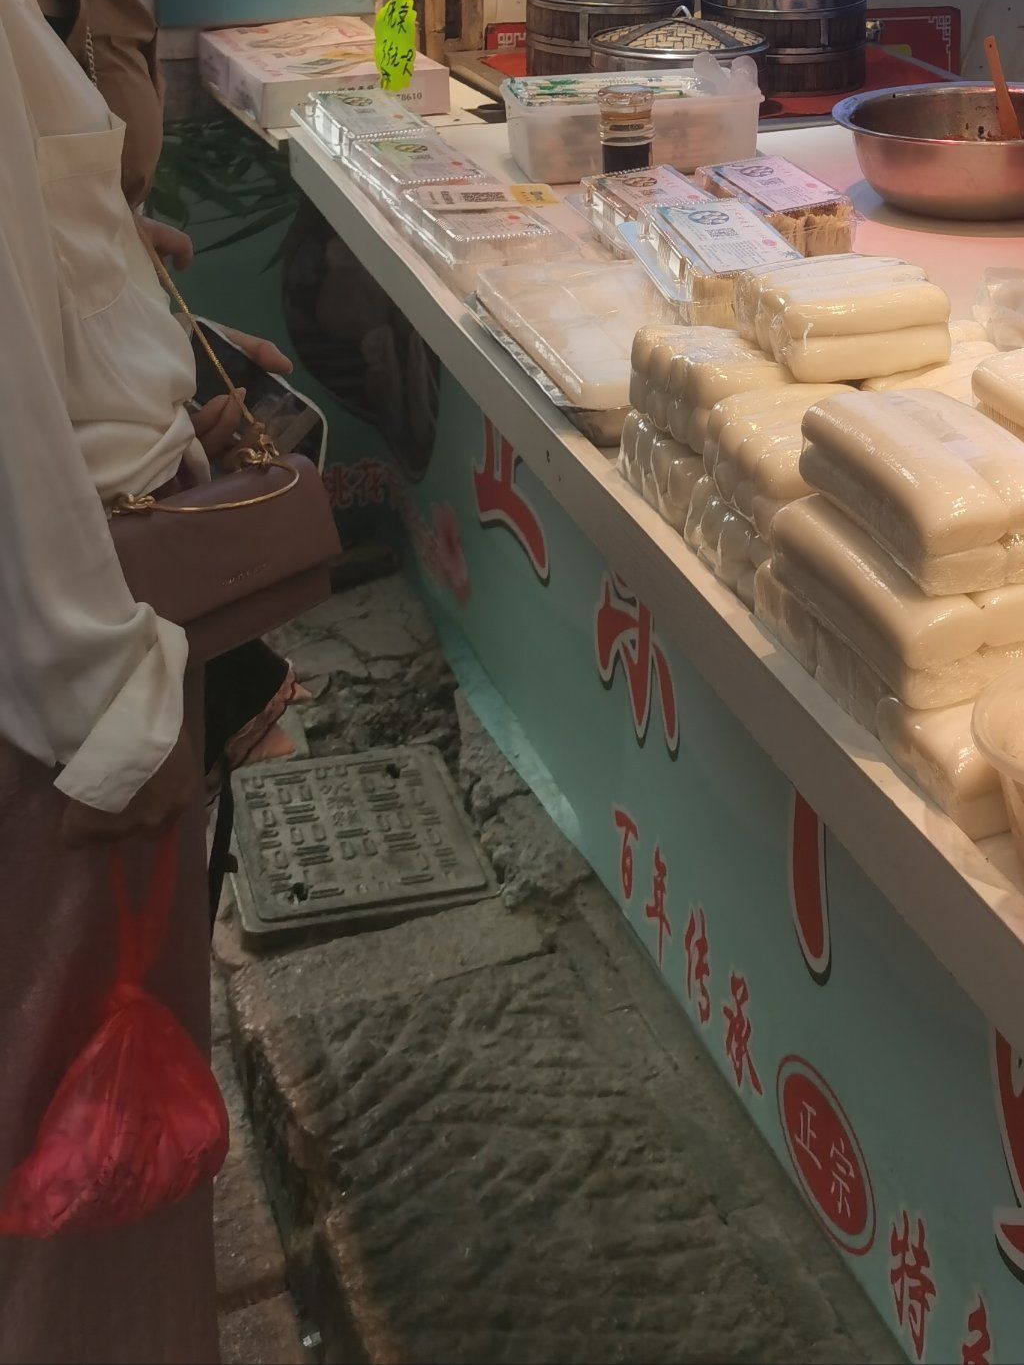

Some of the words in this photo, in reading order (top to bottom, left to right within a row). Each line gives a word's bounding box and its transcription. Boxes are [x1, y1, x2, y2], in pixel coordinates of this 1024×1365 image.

[614, 809, 763, 1097] 百年传承
[793, 1101, 853, 1220] 正宗
